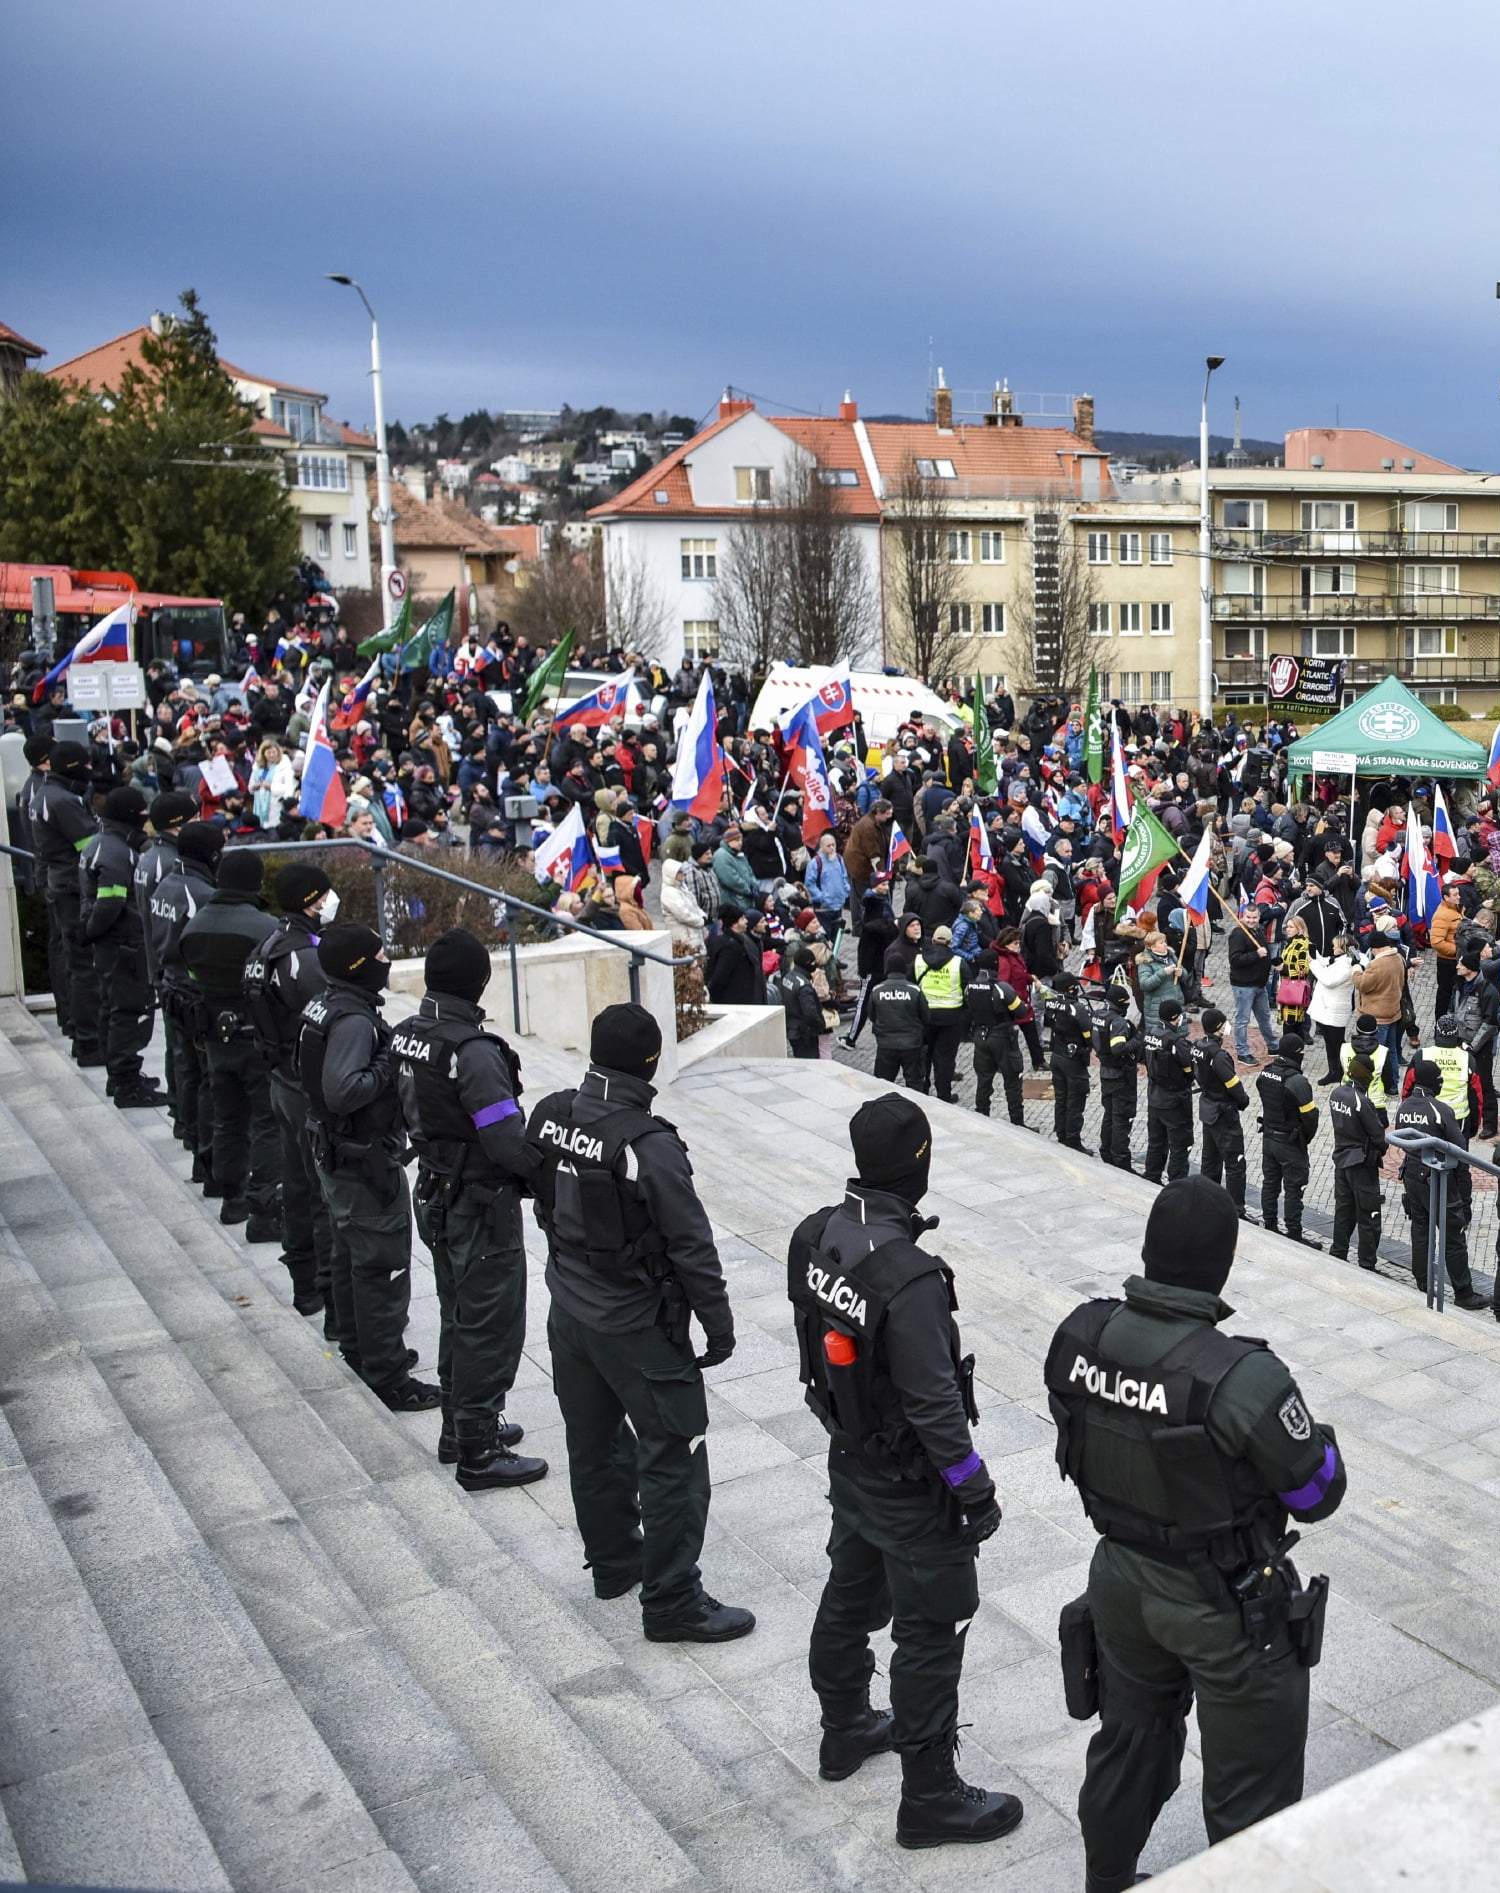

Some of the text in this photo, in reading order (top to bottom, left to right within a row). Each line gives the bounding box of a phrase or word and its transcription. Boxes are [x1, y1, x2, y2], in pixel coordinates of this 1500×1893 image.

[1304, 657, 1326, 669] NORTH
[1300, 669, 1330, 680] ATLANTIC
[1299, 680, 1333, 692] TERRORIST
[1293, 756, 1312, 766] KOTL
[1356, 755, 1371, 766] OVÁ
[1372, 756, 1405, 766] STRANA
[1407, 756, 1429, 767] NAŠE
[1430, 759, 1479, 770] SLOVENSKO
[151, 896, 177, 923] OLÍCIA
[879, 989, 911, 1001] POLÍCIA
[391, 1033, 431, 1062] POLÍCIA
[1261, 1070, 1282, 1082] POLÍCIA
[1399, 1113, 1429, 1125] POLÍCIA
[539, 1119, 603, 1162] POLÍCIA
[1068, 1354, 1168, 1415] POLÍCIA
